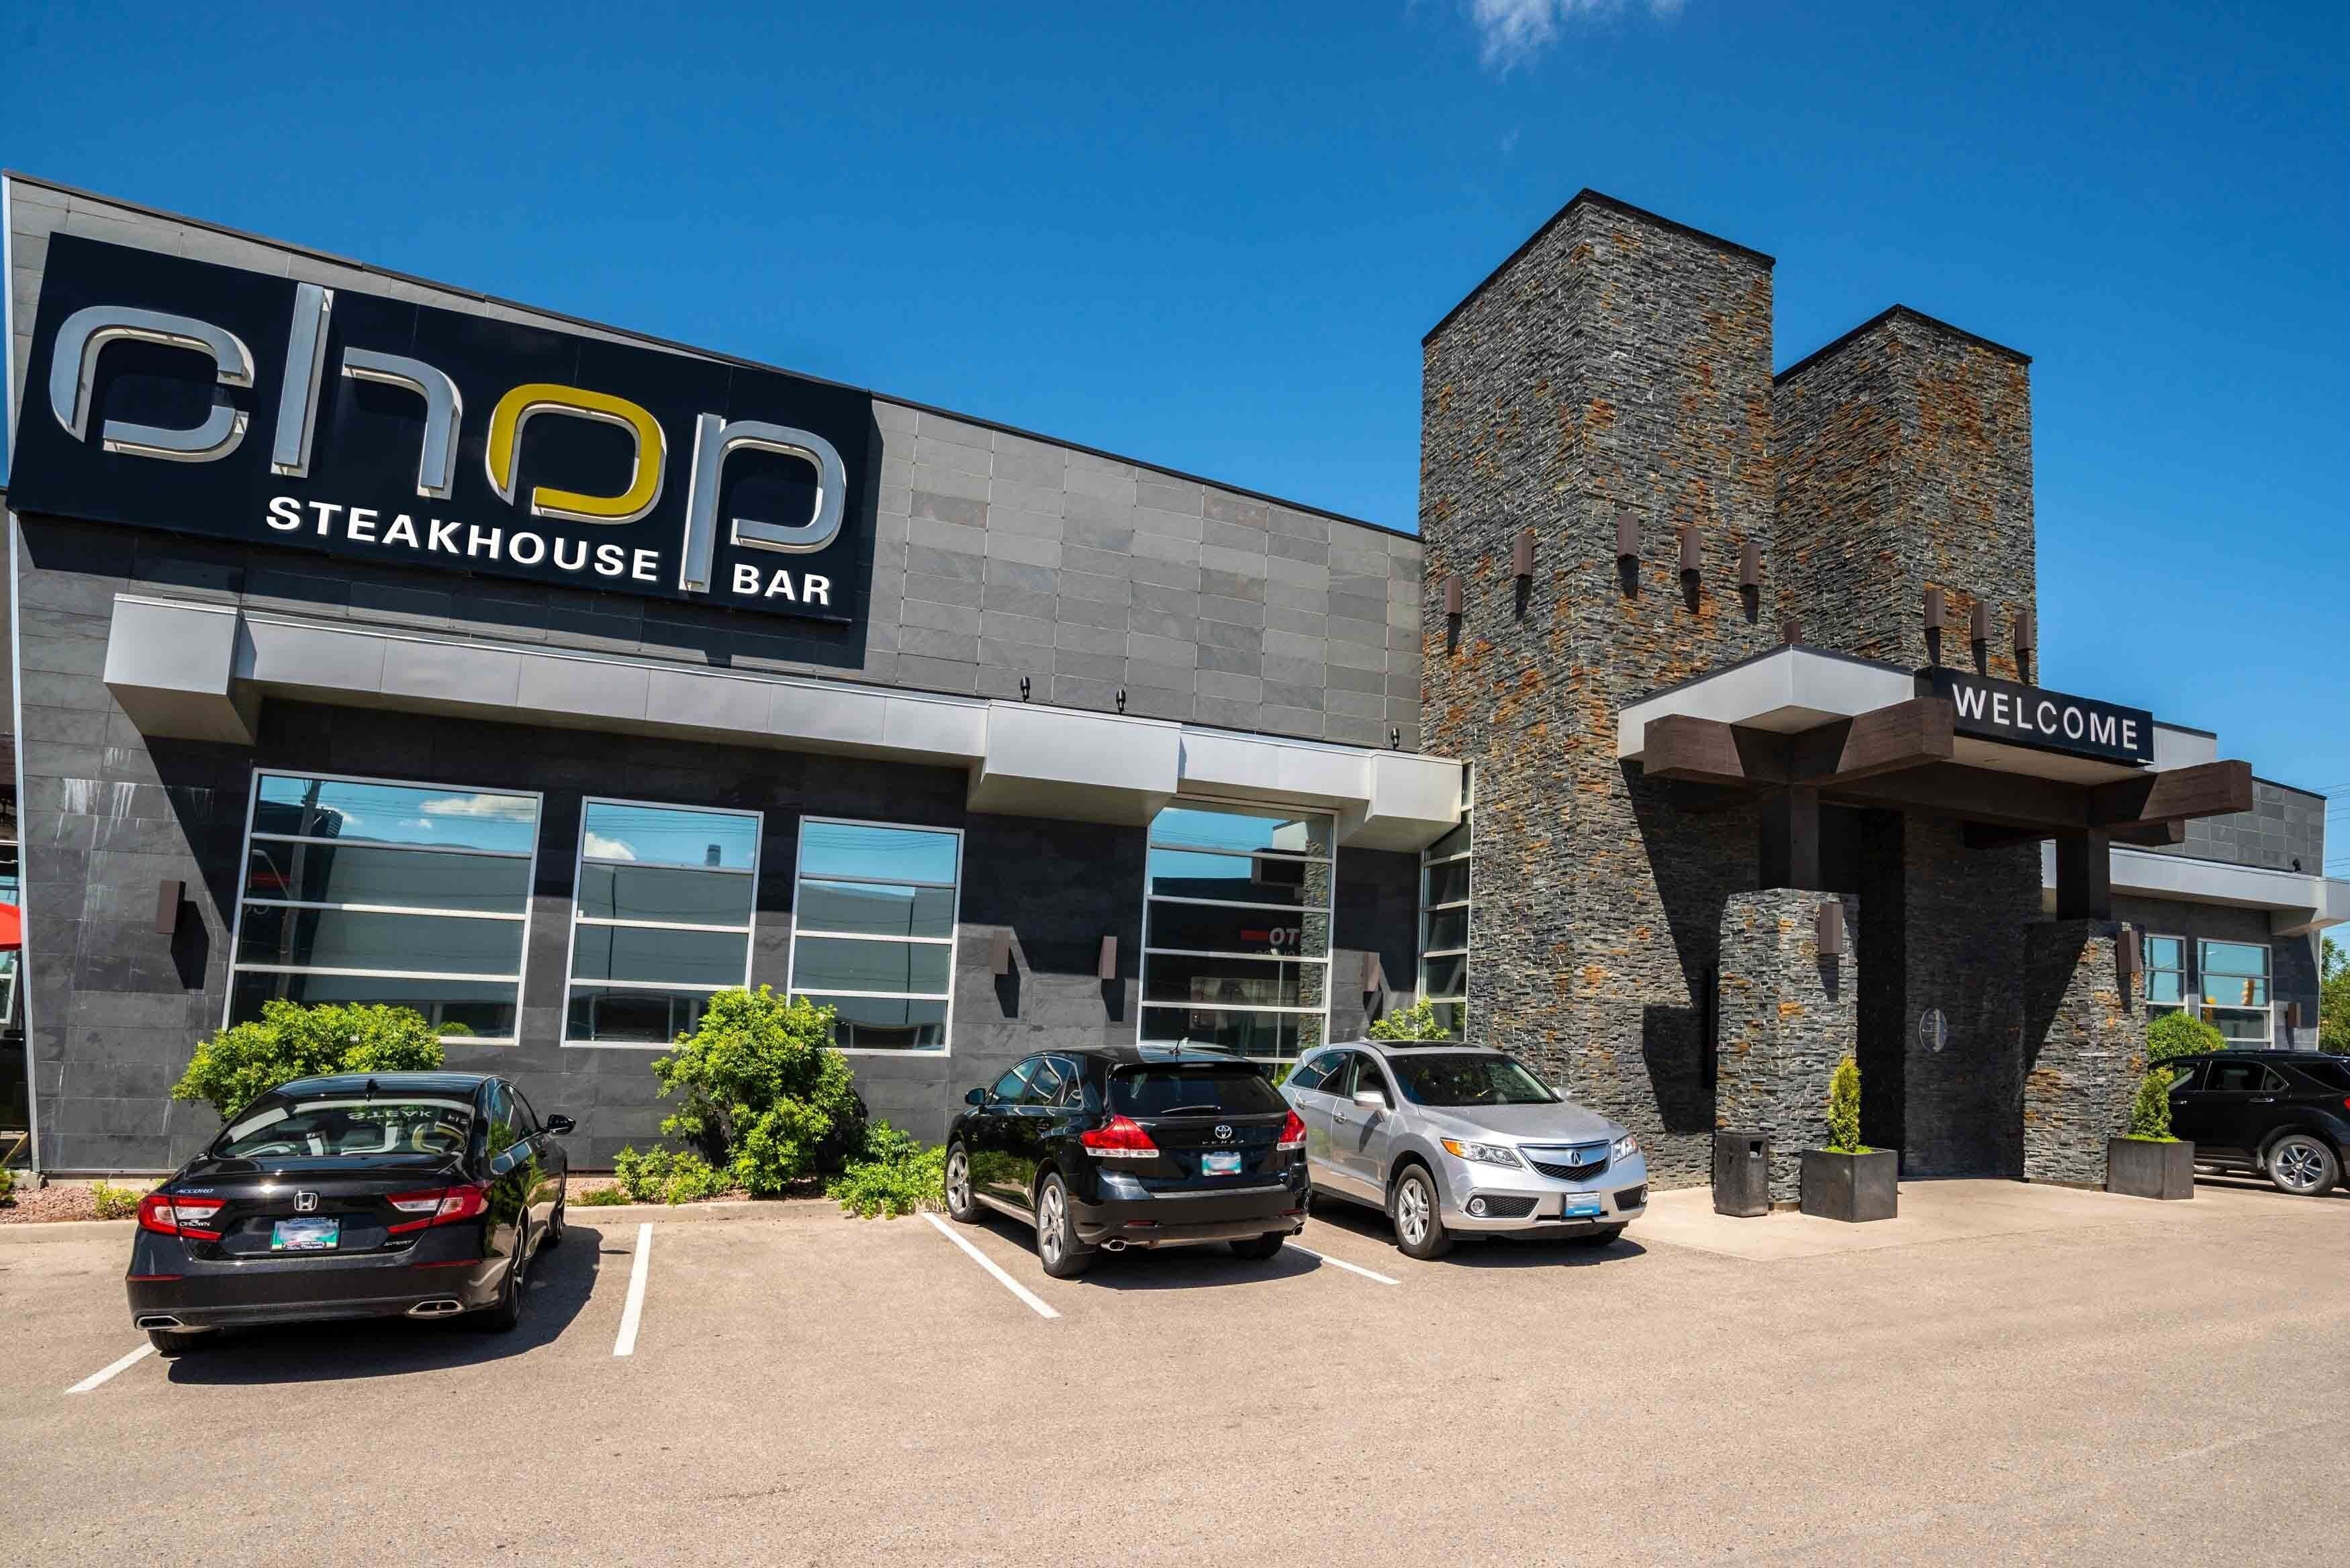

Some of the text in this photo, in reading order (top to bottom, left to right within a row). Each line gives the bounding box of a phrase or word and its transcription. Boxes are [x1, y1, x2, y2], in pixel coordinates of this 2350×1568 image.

[49, 282, 847, 593] chop
[265, 496, 661, 582] STEAKHOUSE
[732, 563, 830, 605] BAR
[1951, 683, 2138, 750] WELCOME
